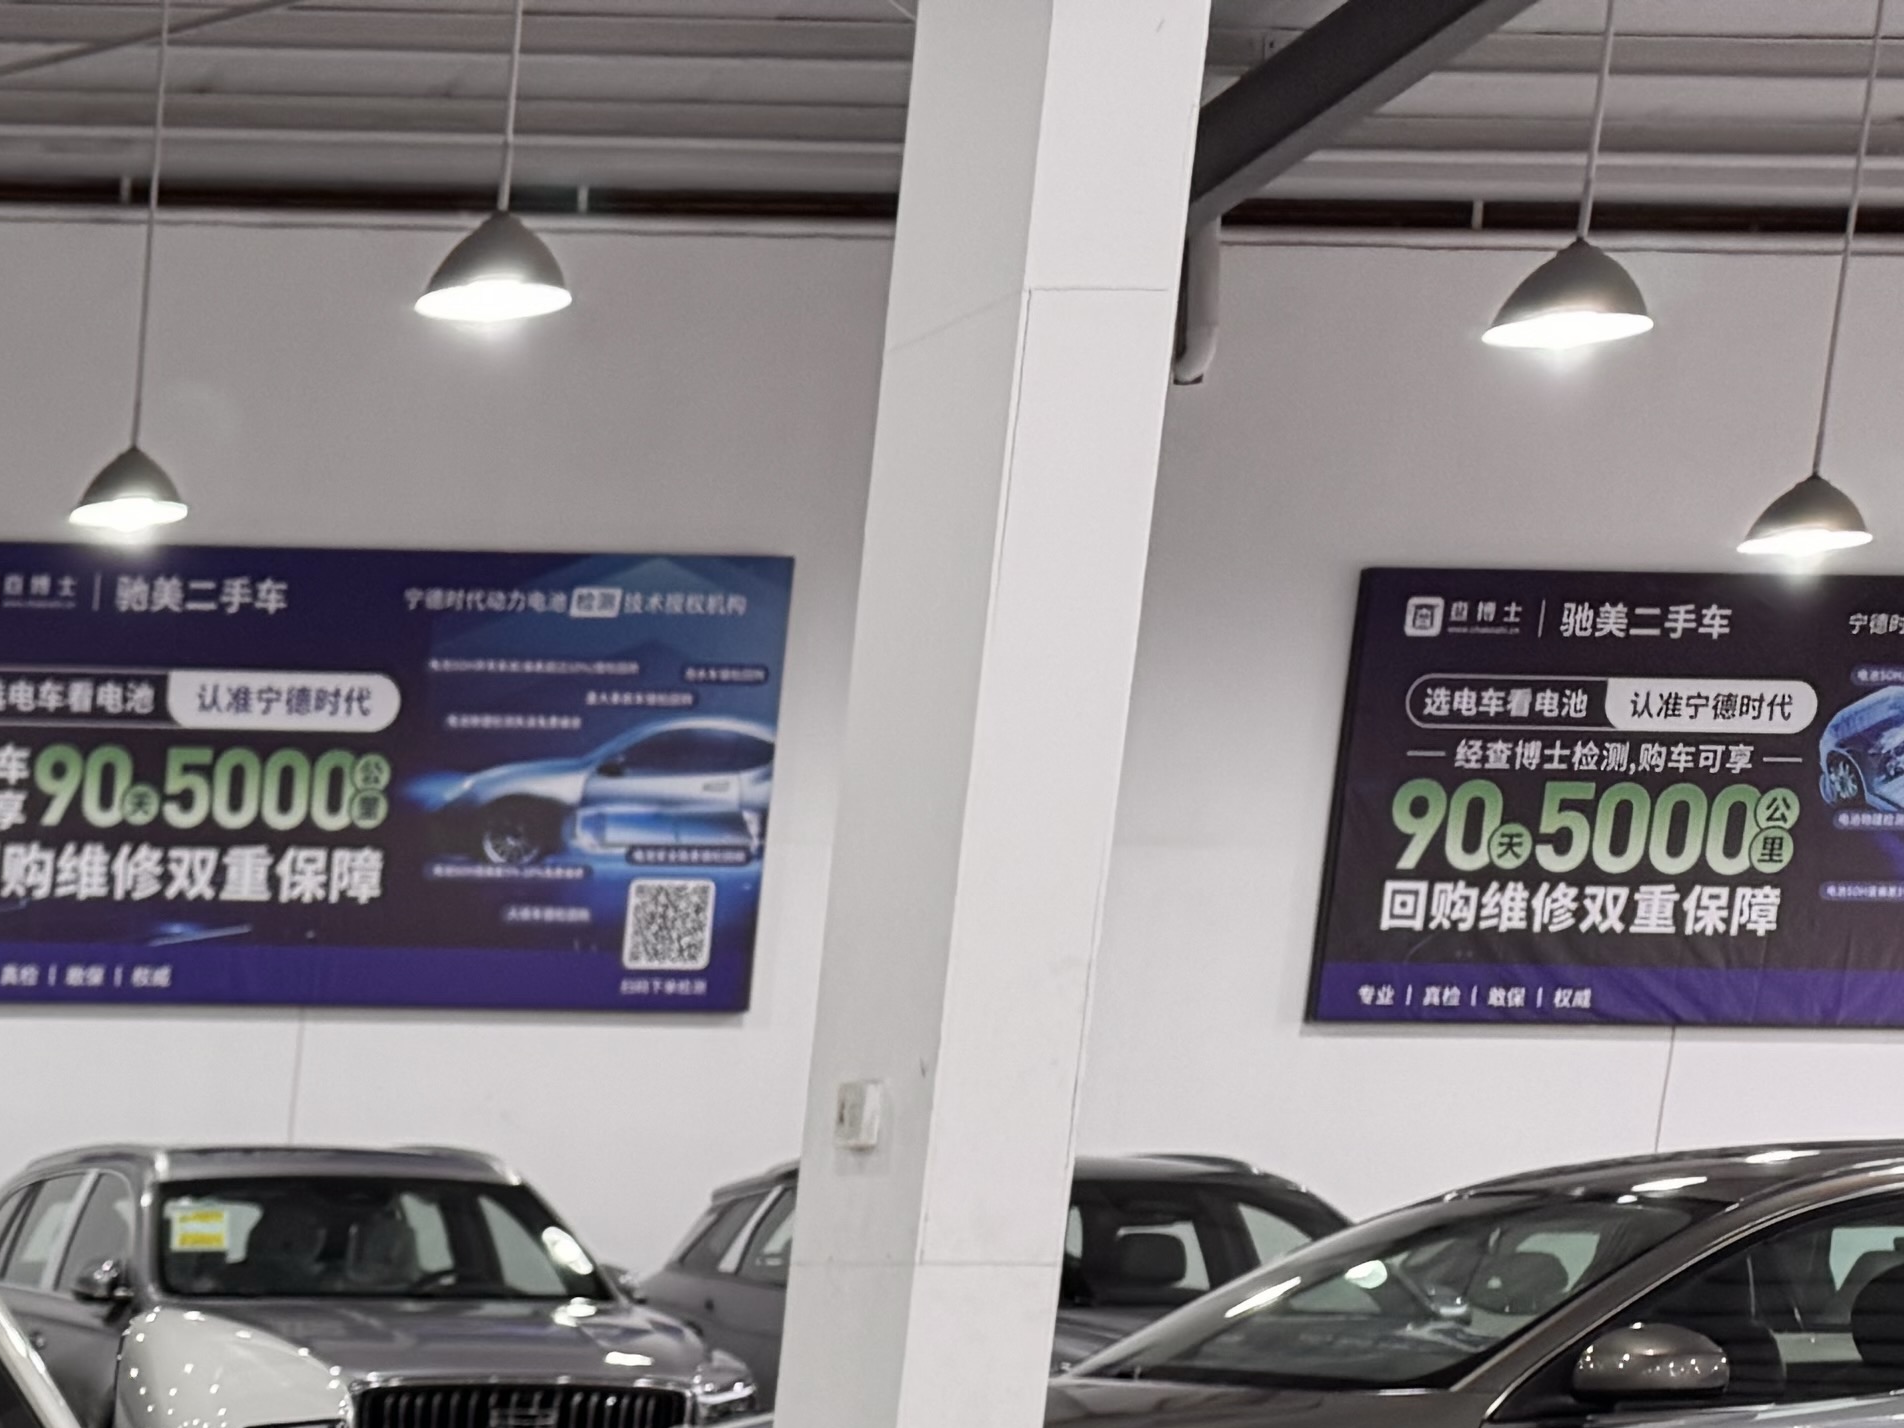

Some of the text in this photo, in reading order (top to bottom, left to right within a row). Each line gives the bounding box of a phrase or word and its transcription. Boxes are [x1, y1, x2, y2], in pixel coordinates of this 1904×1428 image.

[115, 575, 289, 614] 驰美二手车
[1560, 602, 1732, 639] 驰美二手车
[197, 684, 371, 716] 认准宁德时代
[1423, 687, 1588, 718] 选电车看电池
[1630, 692, 1794, 723] 认准宁德时代
[1379, 880, 1782, 936] 回购维修双重保障
[1358, 984, 1395, 1005] 专业
